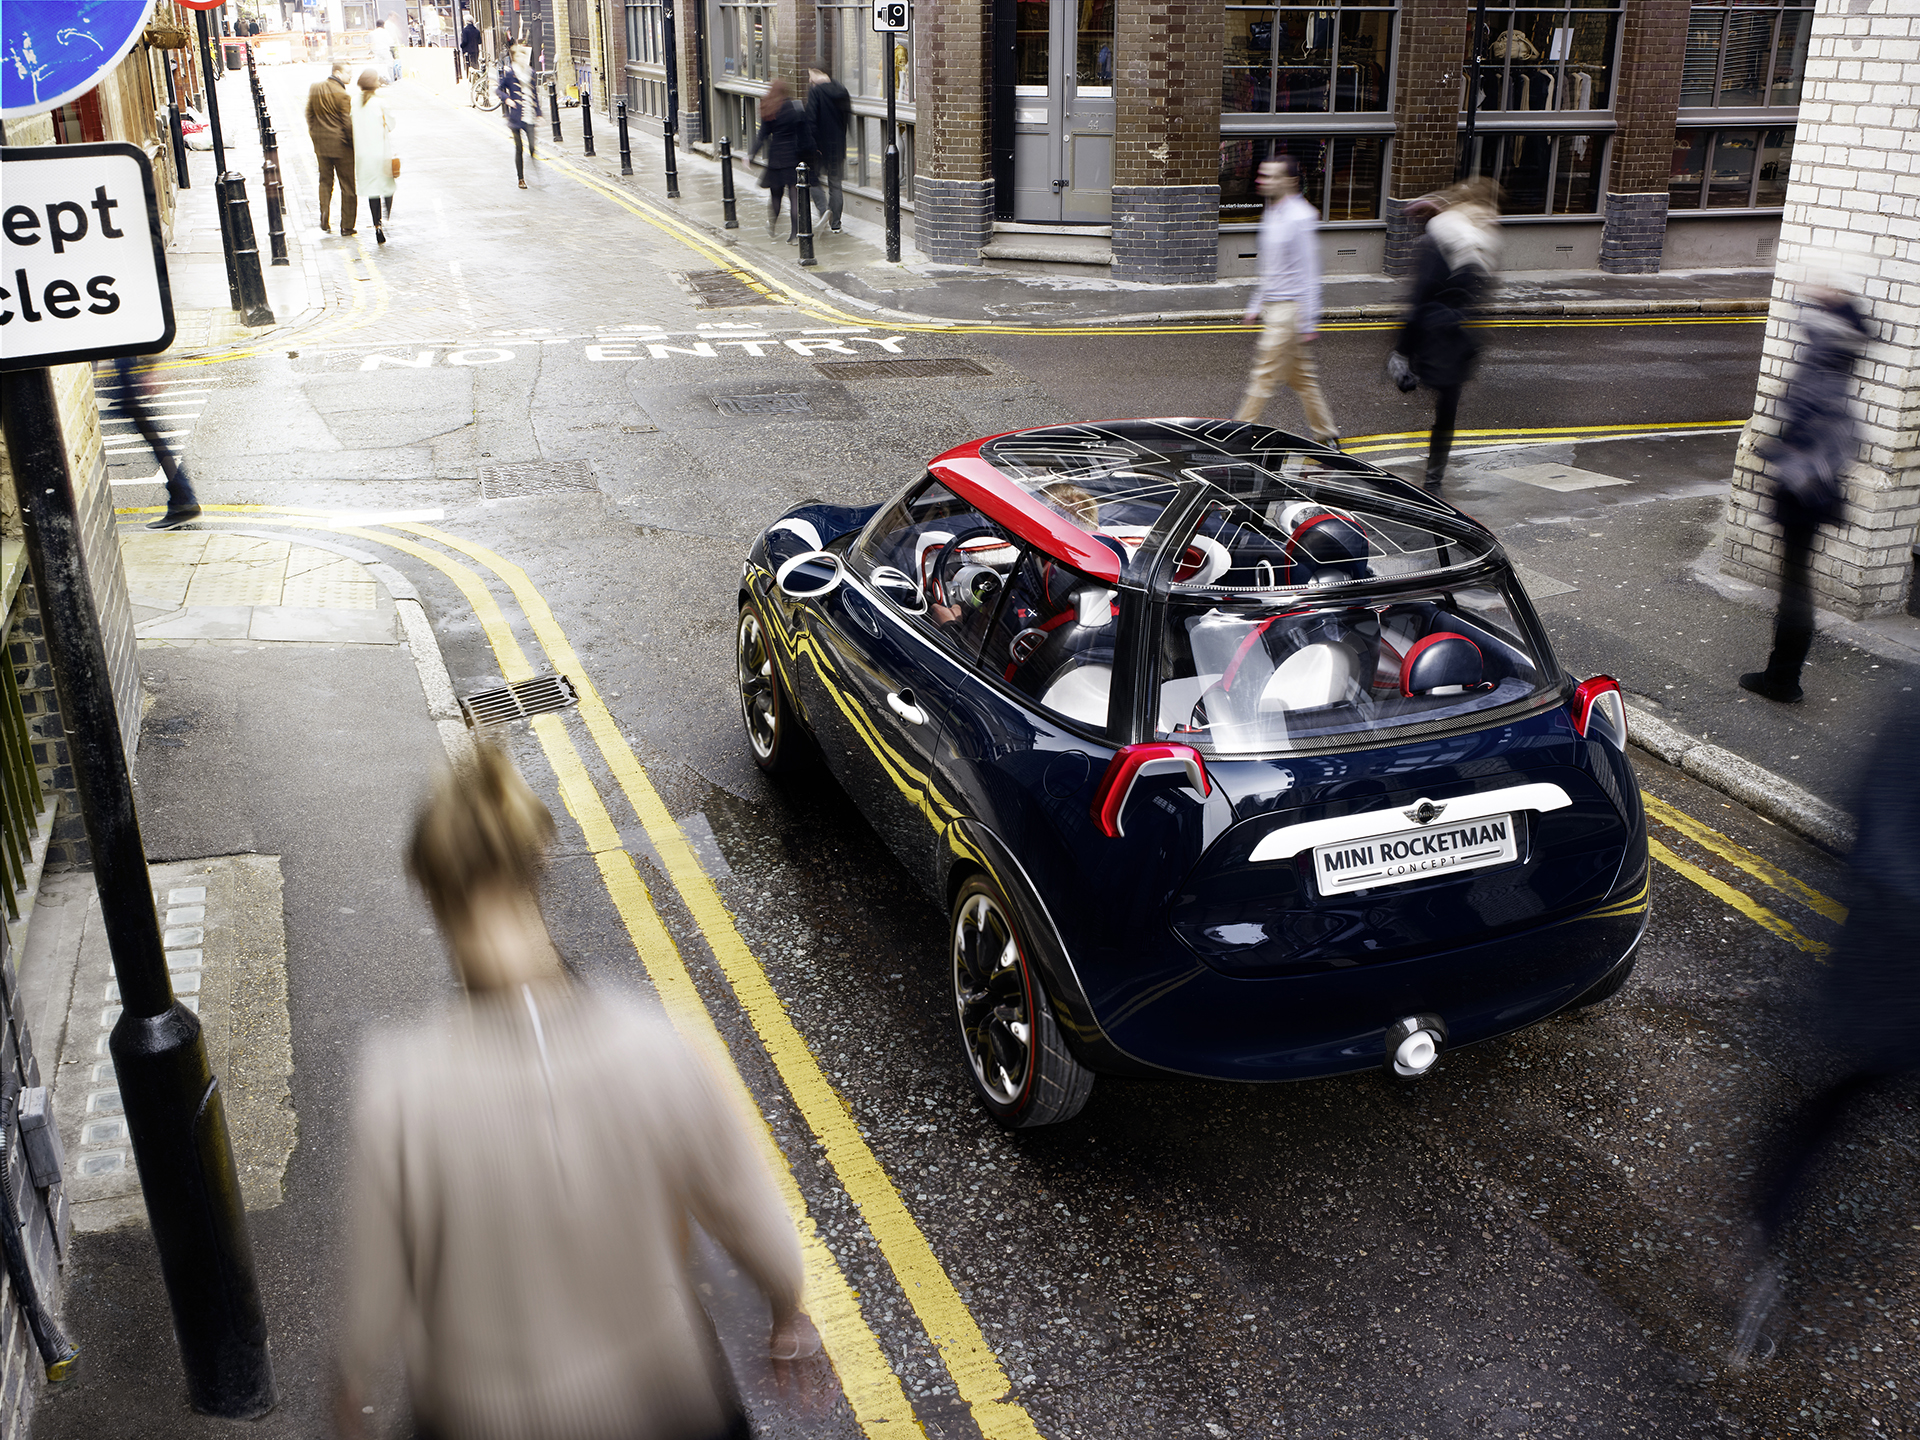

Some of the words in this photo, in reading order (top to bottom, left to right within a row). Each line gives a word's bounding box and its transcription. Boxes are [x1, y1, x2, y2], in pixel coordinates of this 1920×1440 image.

[1087, 120, 1100, 130] 44
[2, 185, 125, 254] ept
[359, 347, 517, 372] NO
[585, 336, 908, 363] ENTRY
[1323, 846, 1375, 873] MINI
[1379, 821, 1508, 863] ROCKETMAN
[1386, 855, 1458, 878] CONCEPT
